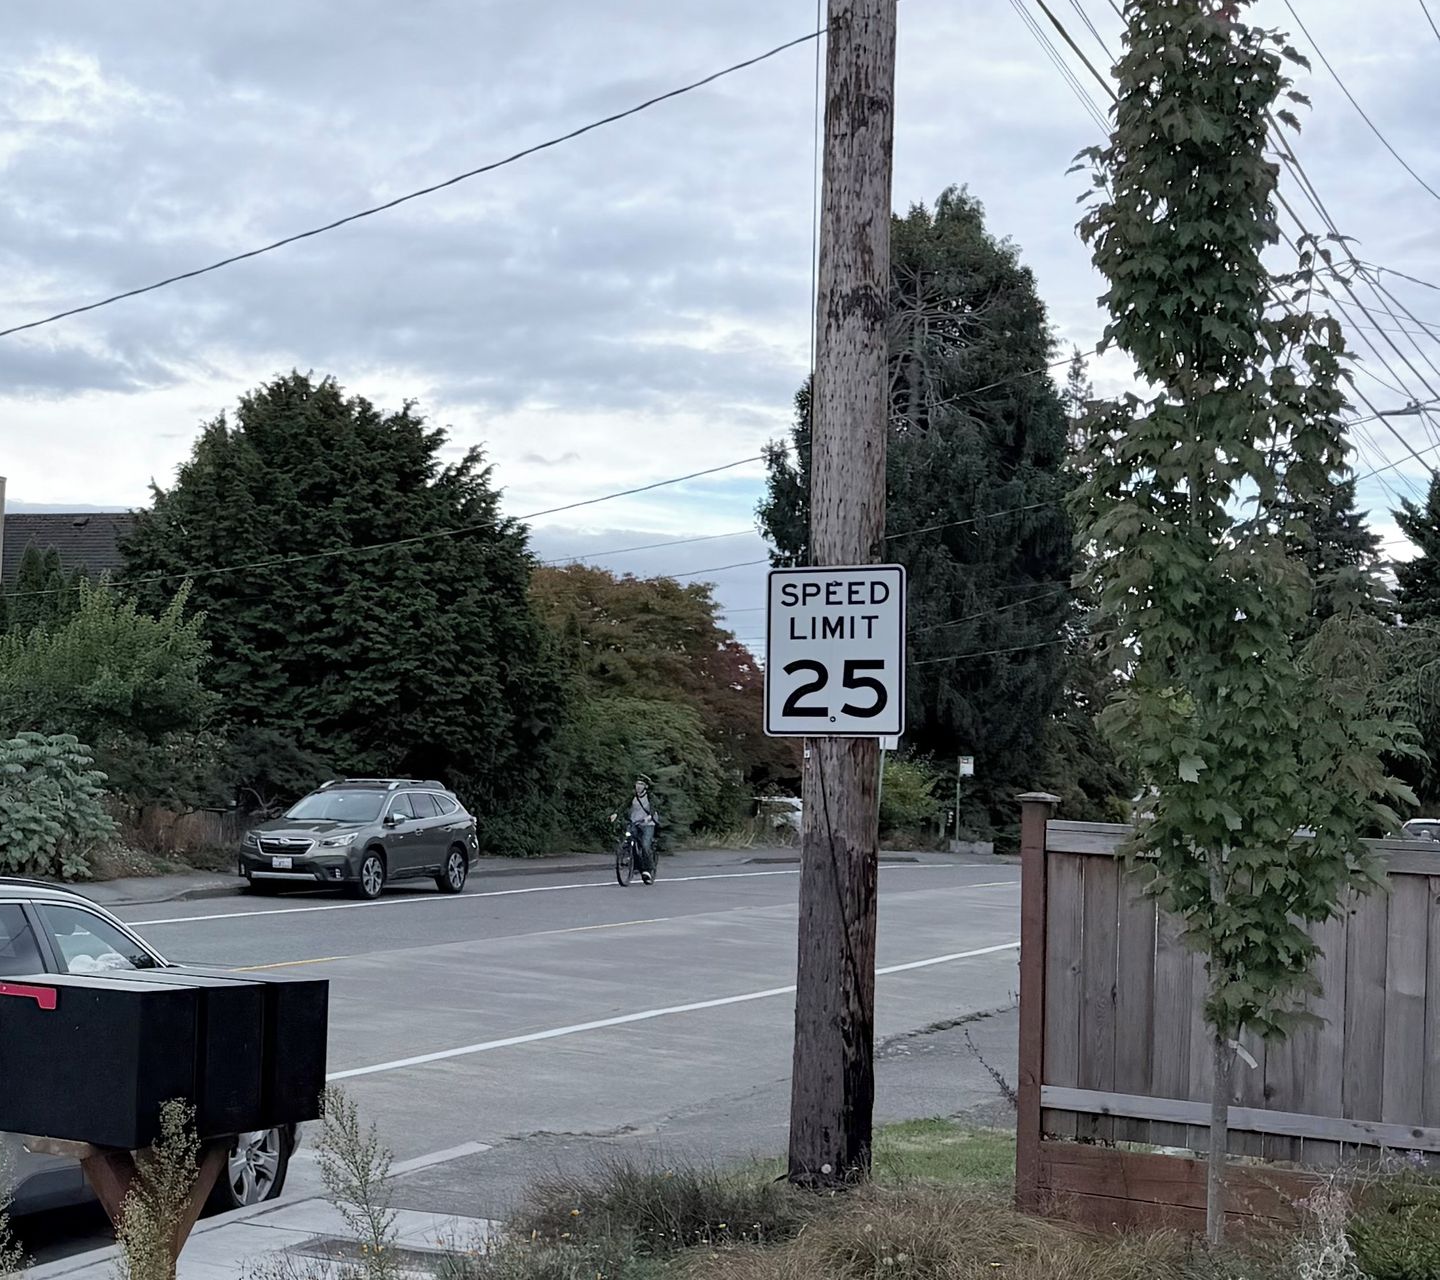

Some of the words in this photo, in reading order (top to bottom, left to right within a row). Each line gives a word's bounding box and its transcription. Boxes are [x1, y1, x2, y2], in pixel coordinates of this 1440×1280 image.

[781, 580, 890, 607] SPEED
[789, 615, 879, 640] LIMIT
[782, 659, 888, 718] 25
